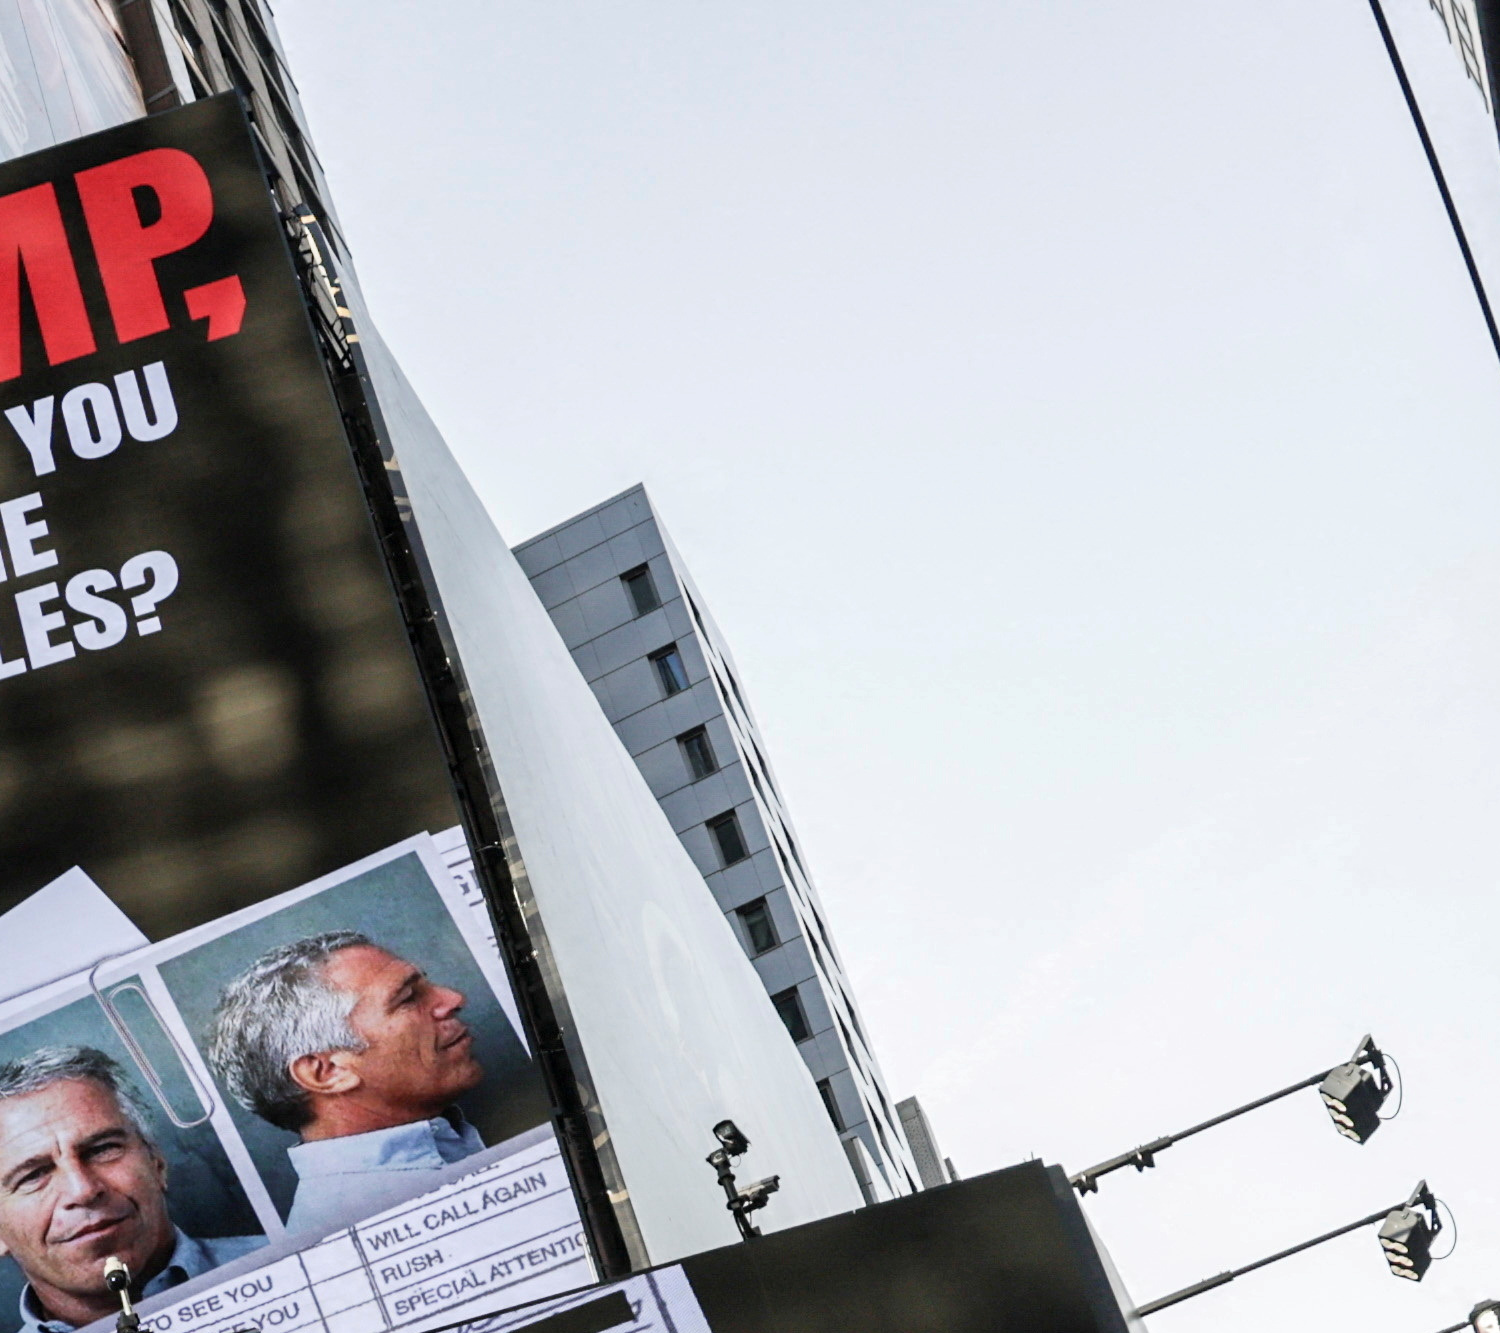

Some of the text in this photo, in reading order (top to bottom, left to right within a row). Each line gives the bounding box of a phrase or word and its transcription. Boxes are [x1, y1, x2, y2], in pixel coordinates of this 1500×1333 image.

[6, 360, 179, 477] YOU
[365, 1172, 548, 1253] WILL CALL AGAIN
